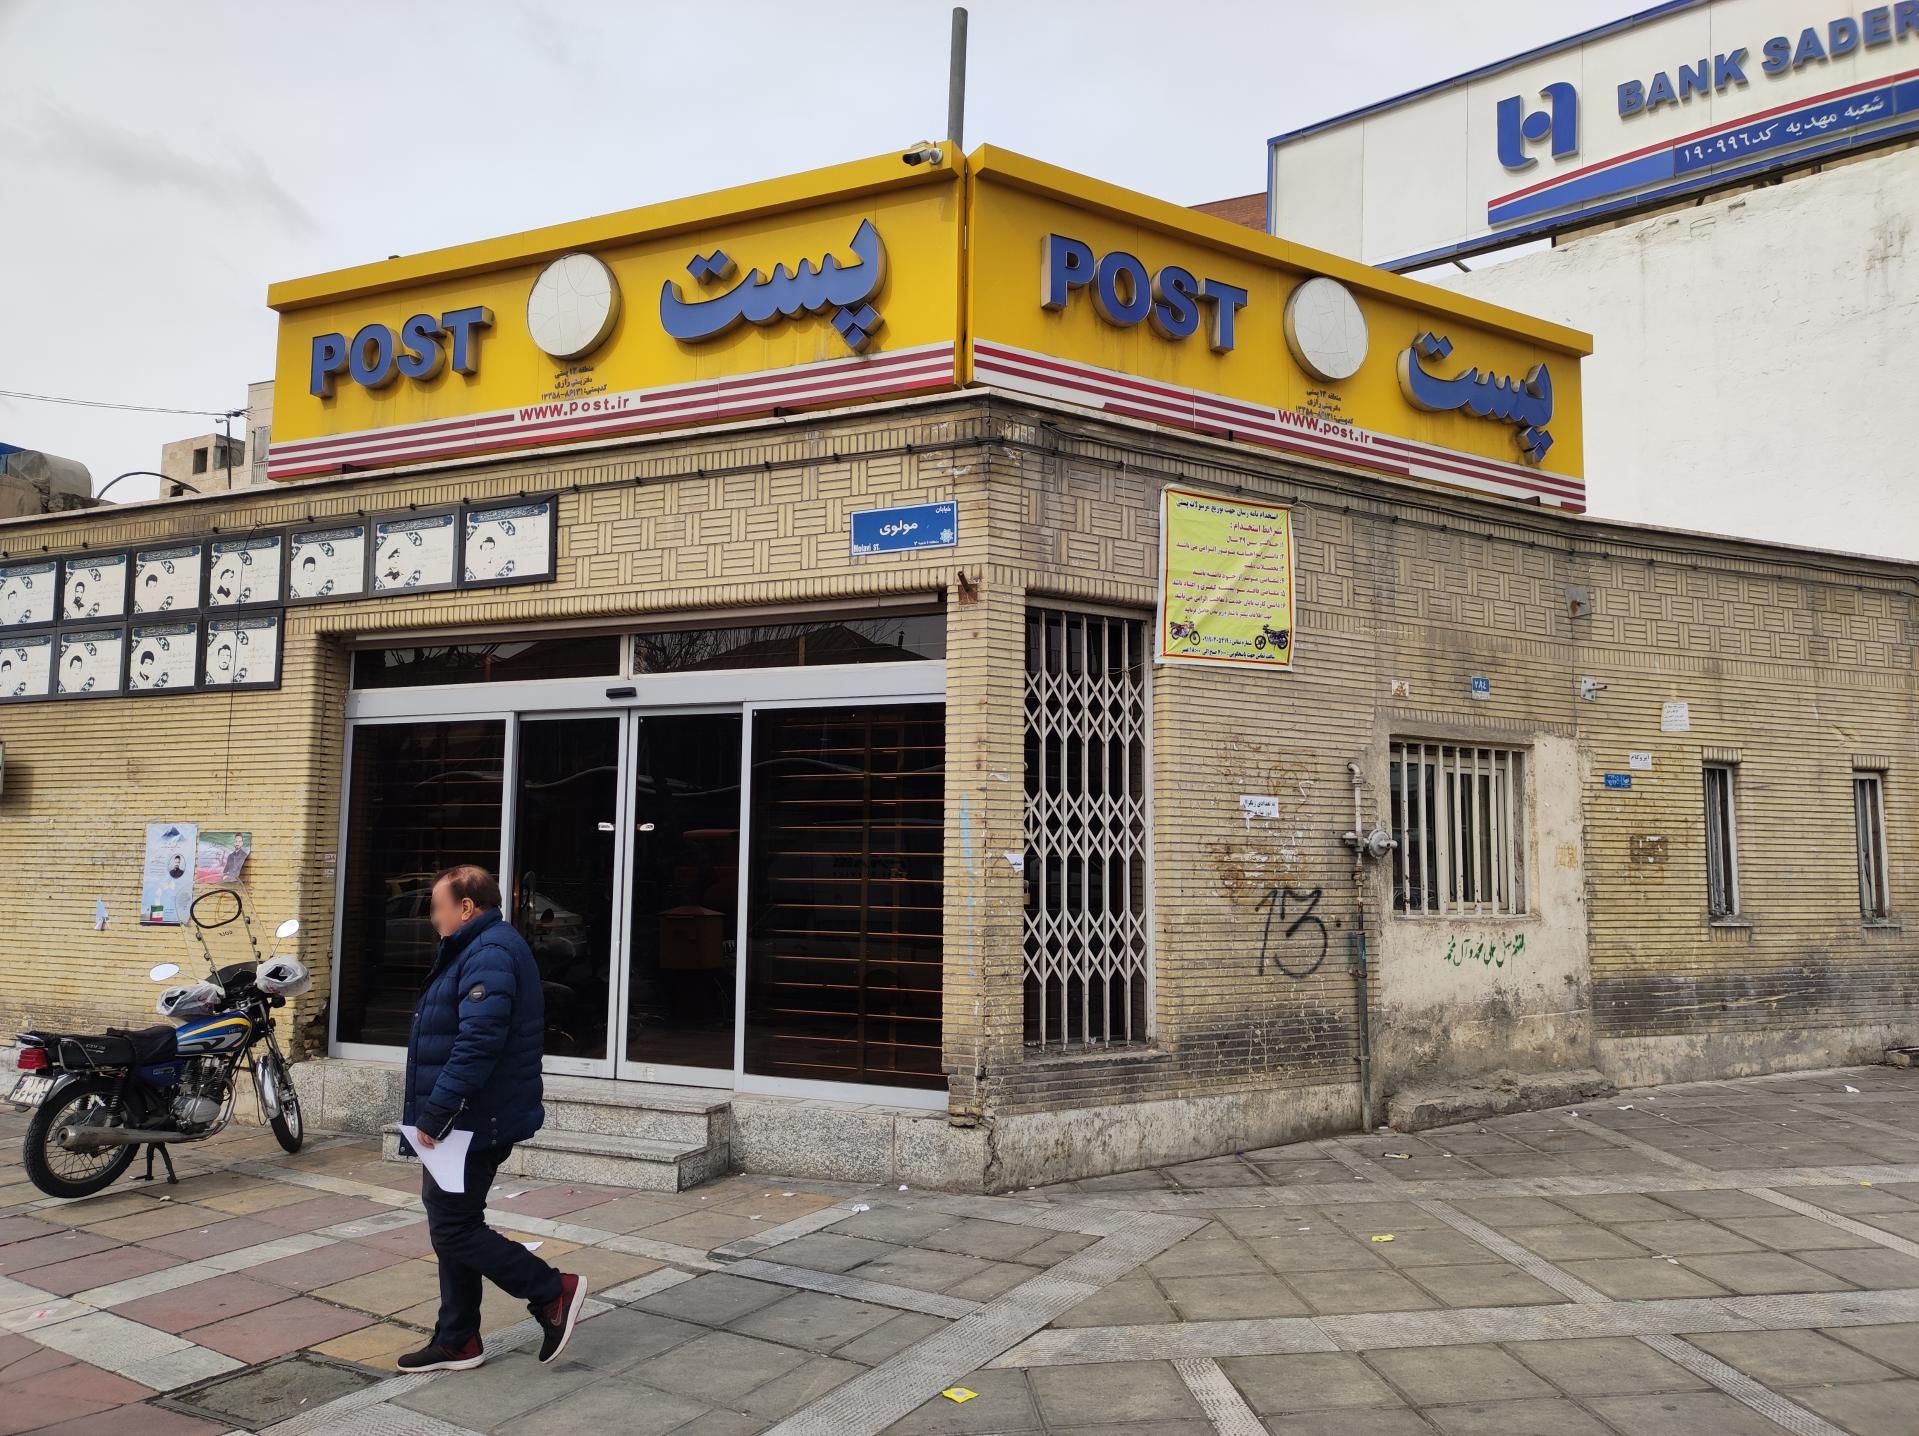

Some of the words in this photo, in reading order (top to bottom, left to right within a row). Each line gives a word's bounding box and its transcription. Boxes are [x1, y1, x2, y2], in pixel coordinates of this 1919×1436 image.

[1617, 46, 1748, 117] BANK
[1844, 96, 1885, 119] شعبه
[1786, 113, 1838, 136] مهدیه
[659, 219, 888, 353] پست
[1040, 233, 1248, 354] POST
[310, 305, 492, 398] POST
[1397, 331, 1554, 464] پست
[879, 519, 919, 537] مولوی
[935, 505, 952, 514] خیابان
